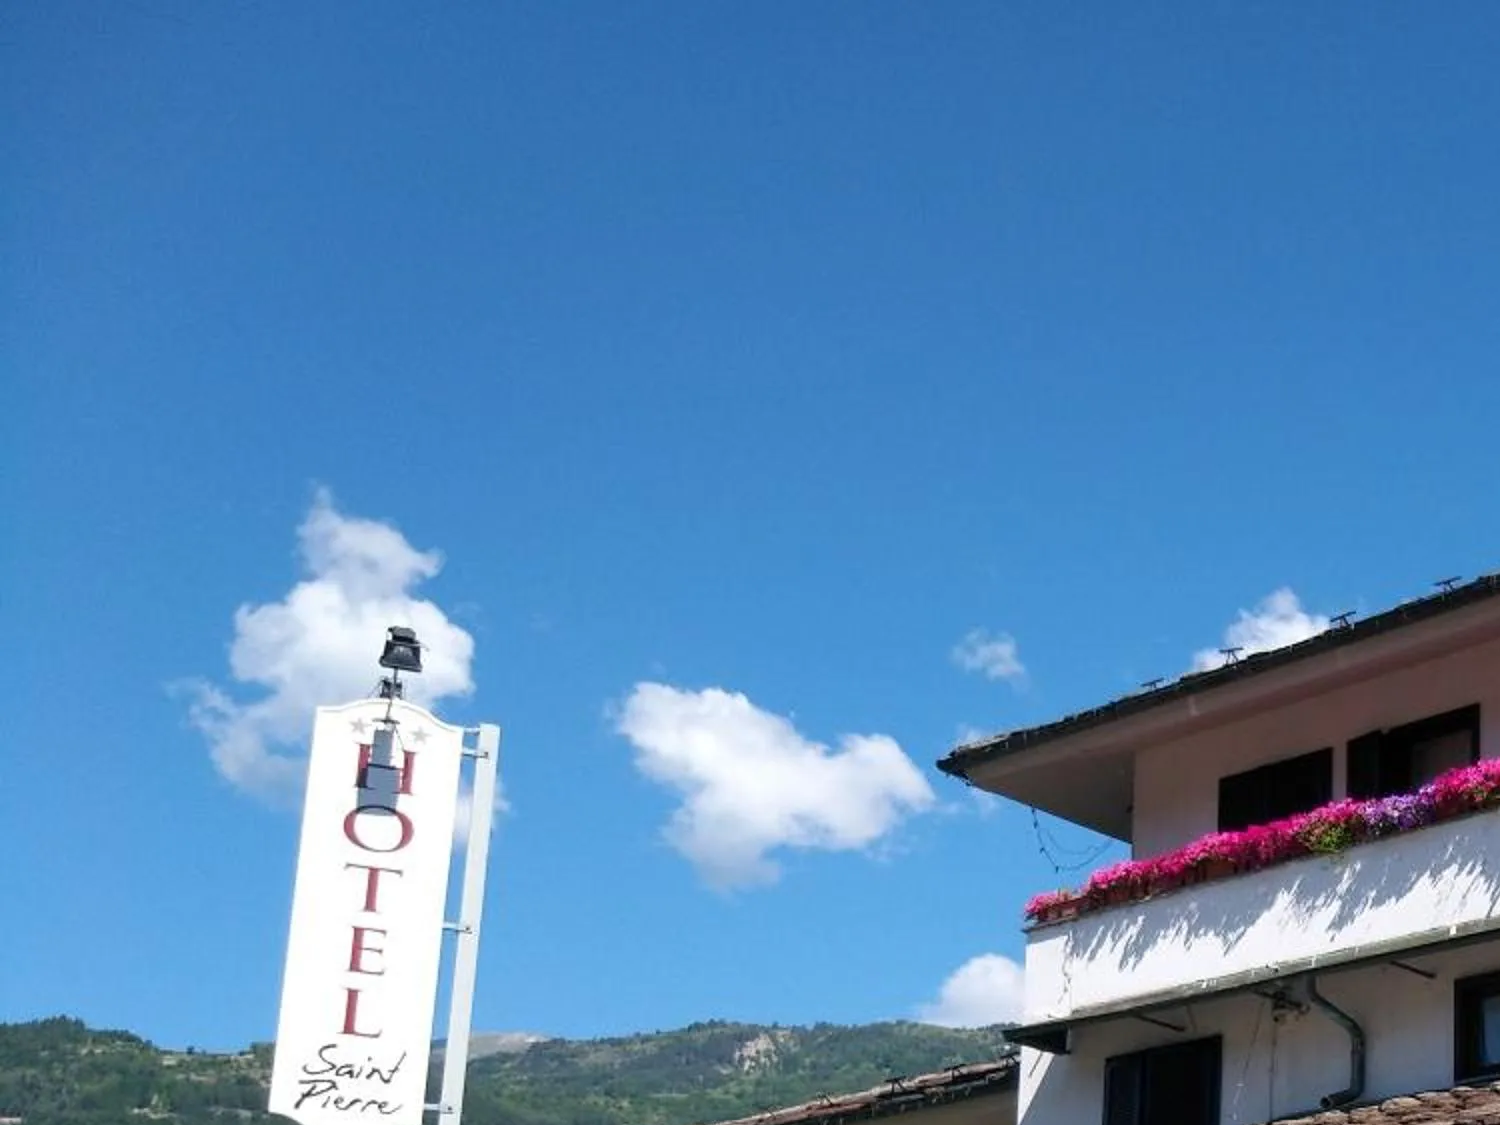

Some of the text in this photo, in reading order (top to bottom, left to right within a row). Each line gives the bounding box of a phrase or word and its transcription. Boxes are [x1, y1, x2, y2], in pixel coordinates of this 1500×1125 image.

[336, 742, 418, 1039] HOTEL
[301, 1043, 407, 1084] Saint
[294, 1079, 404, 1115] Pierre
